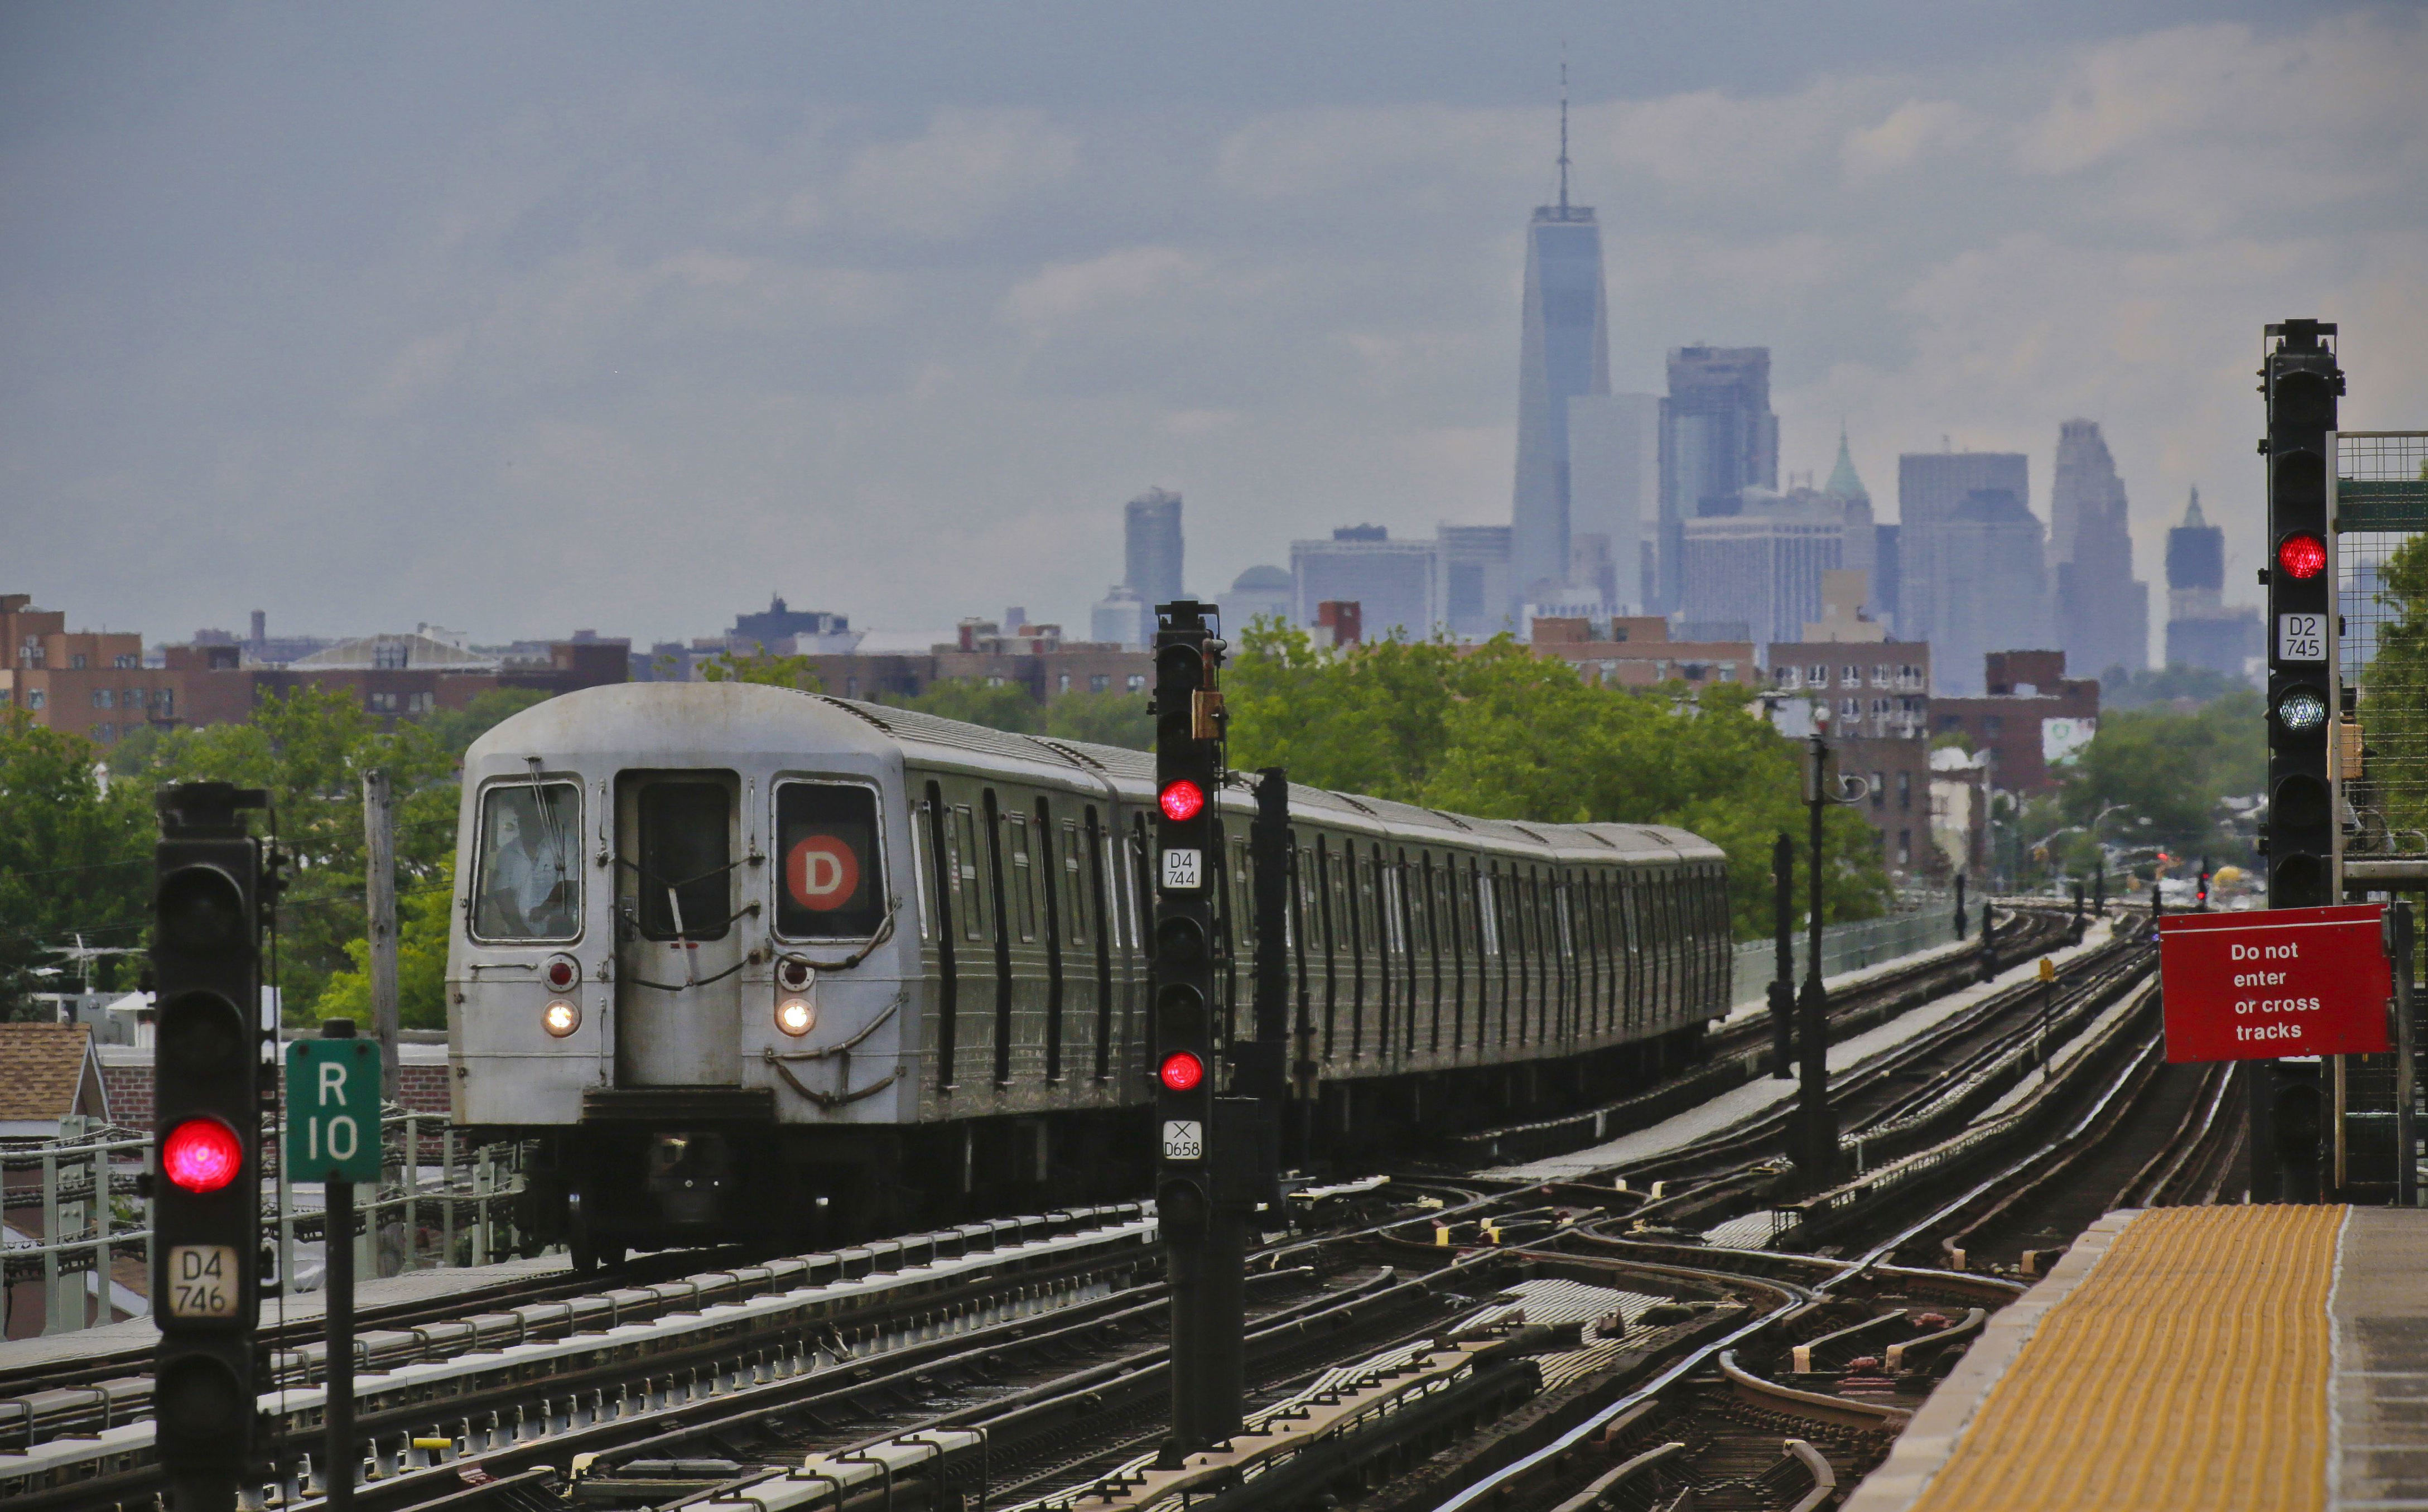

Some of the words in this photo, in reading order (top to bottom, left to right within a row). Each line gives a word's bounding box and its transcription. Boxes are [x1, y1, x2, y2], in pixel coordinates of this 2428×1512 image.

[2290, 617, 2316, 636] D2
[2286, 639, 2320, 657] 745
[1170, 853, 1193, 869] D4
[806, 851, 843, 895] D
[1168, 871, 1195, 886] 744
[2231, 944, 2260, 961] Do
[2265, 942, 2299, 959] not
[2233, 971, 2286, 988] enter
[2235, 1000, 2256, 1014] or
[2262, 997, 2320, 1013] cross
[2236, 1022, 2302, 1041] tracks
[319, 1062, 347, 1106] R
[1173, 1121, 1192, 1139] X
[1164, 1142, 1201, 1157] D658
[183, 1251, 221, 1280] D4
[176, 1285, 226, 1313] 746
